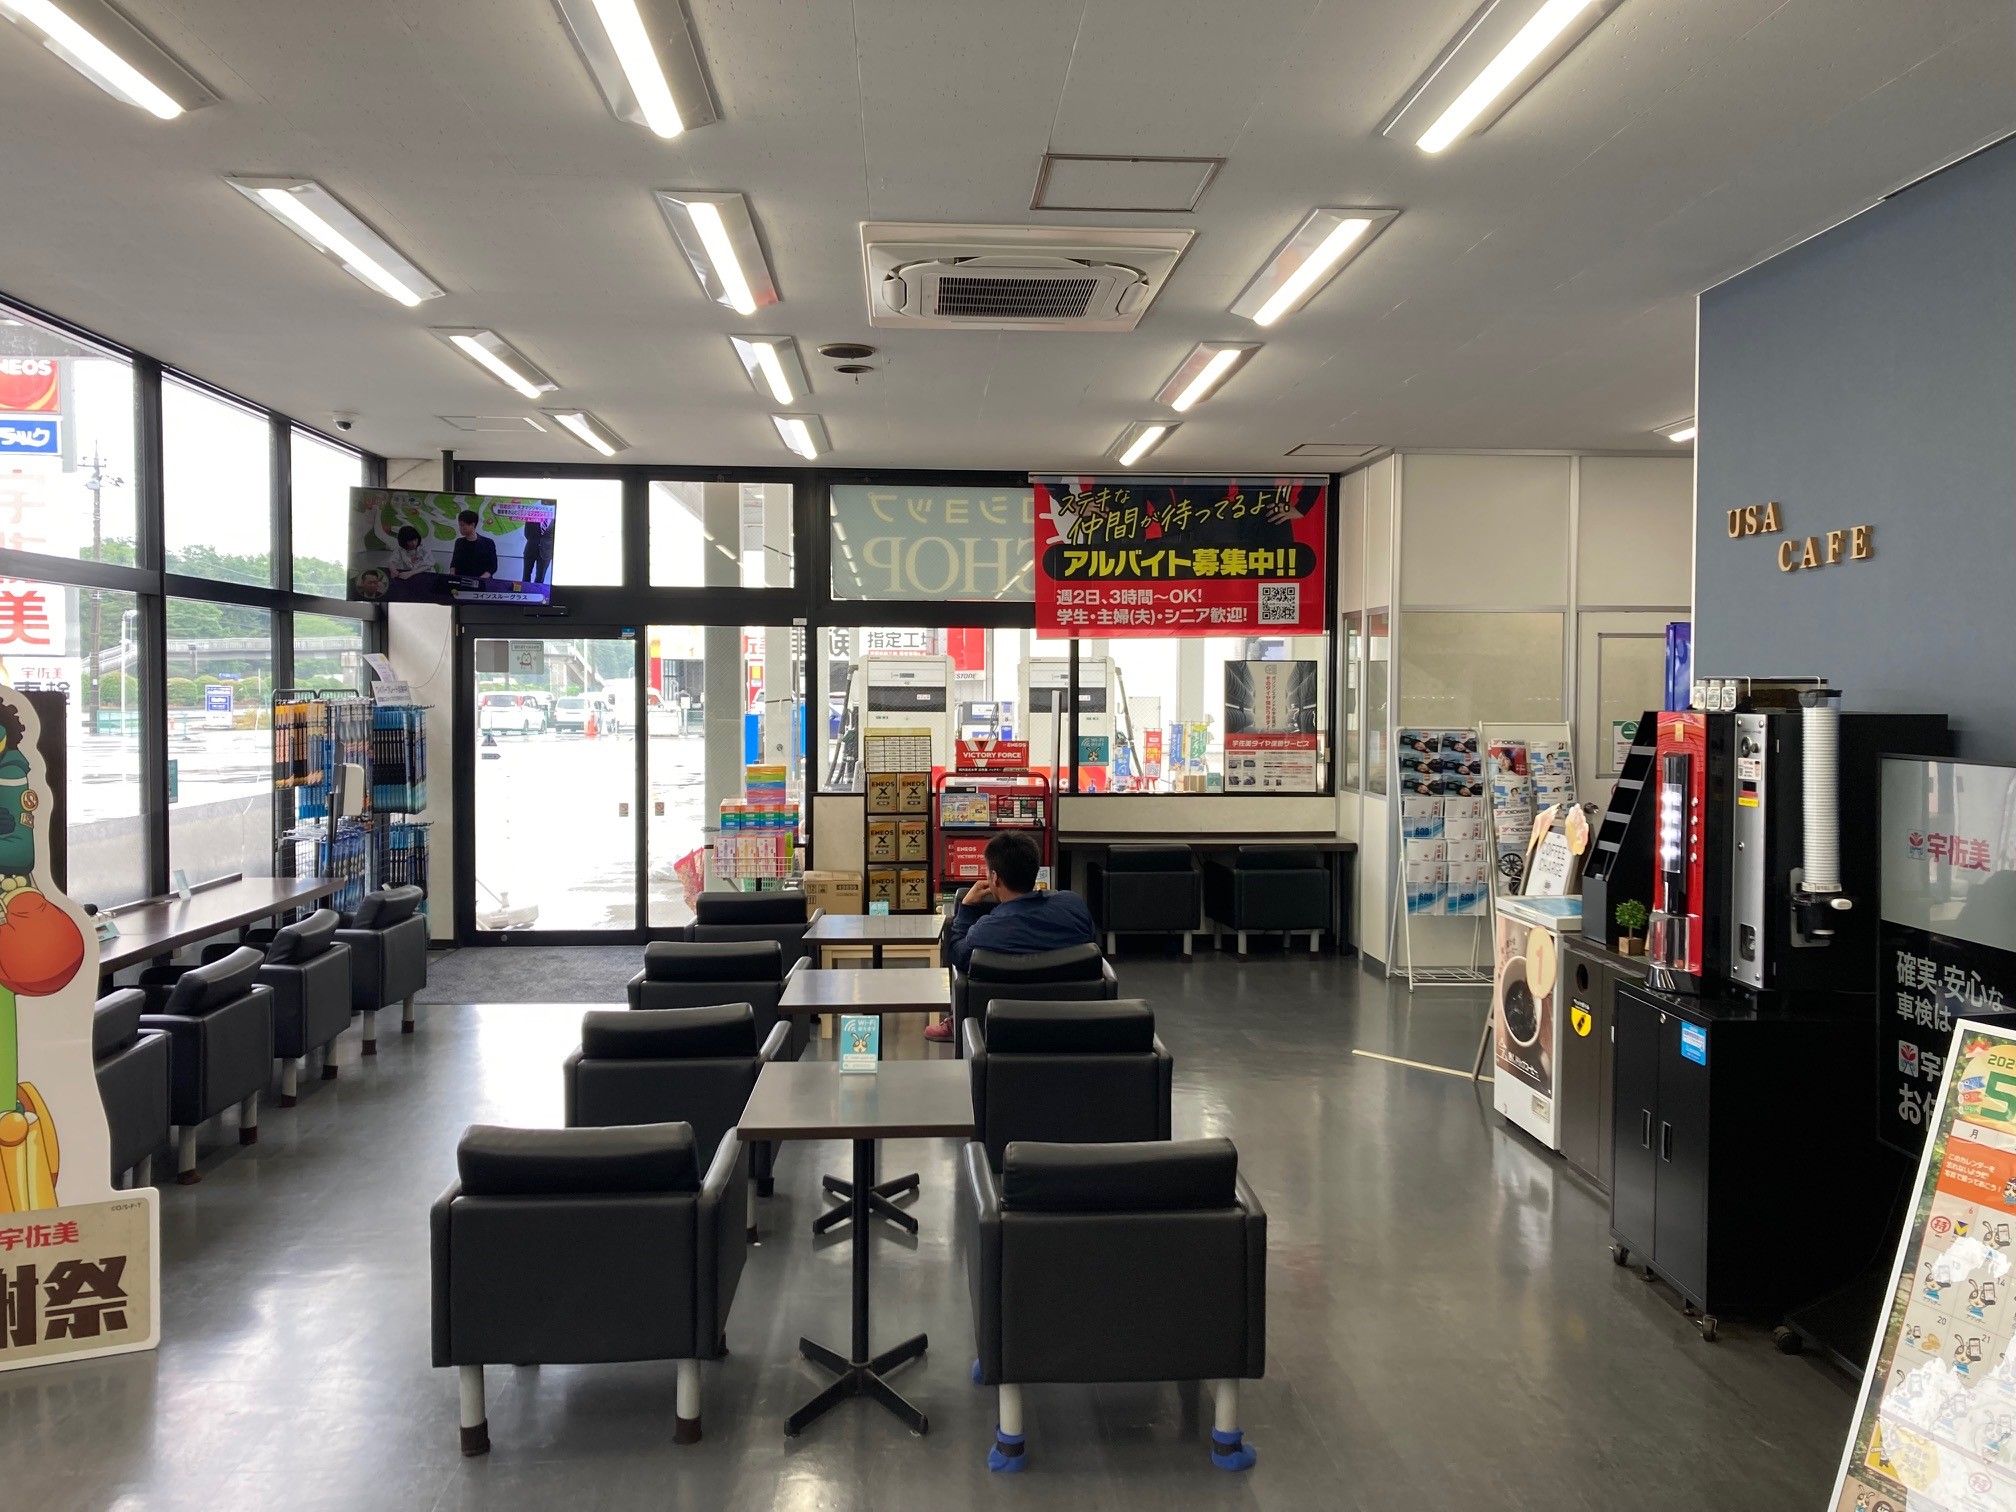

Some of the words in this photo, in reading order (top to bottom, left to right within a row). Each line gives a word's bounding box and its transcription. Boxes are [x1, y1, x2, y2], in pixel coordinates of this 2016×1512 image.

[1059, 487, 1131, 517] ステキな
[1067, 485, 1292, 546] 仲間が待ってるよ!!
[1727, 500, 1781, 538] USA
[1778, 525, 1874, 572] CAFE
[1064, 548, 1296, 578] アルバイト募集中!!
[473, 593, 528, 601] コインスルーグラス
[1056, 607, 1248, 626] 学生・主婦(夫)・シニア歓迎!
[879, 787, 888, 795] X
[909, 787, 919, 795] X
[878, 836, 887, 844] X
[908, 836, 918, 844] X
[1927, 833, 1991, 872] 宇佐美
[878, 884, 888, 893] X
[908, 884, 918, 892] X
[1897, 951, 2004, 1013] 確実・安心な
[1920, 1051, 1947, 1083] 宇
[1970, 1129, 1979, 1139] 月
[1968, 1206, 1974, 1215] 6
[0, 1221, 79, 1252] 宇佐美
[1997, 1277, 2006, 1287] 14
[1937, 1315, 1947, 1325] 20
[1981, 1334, 1991, 1344] 21
